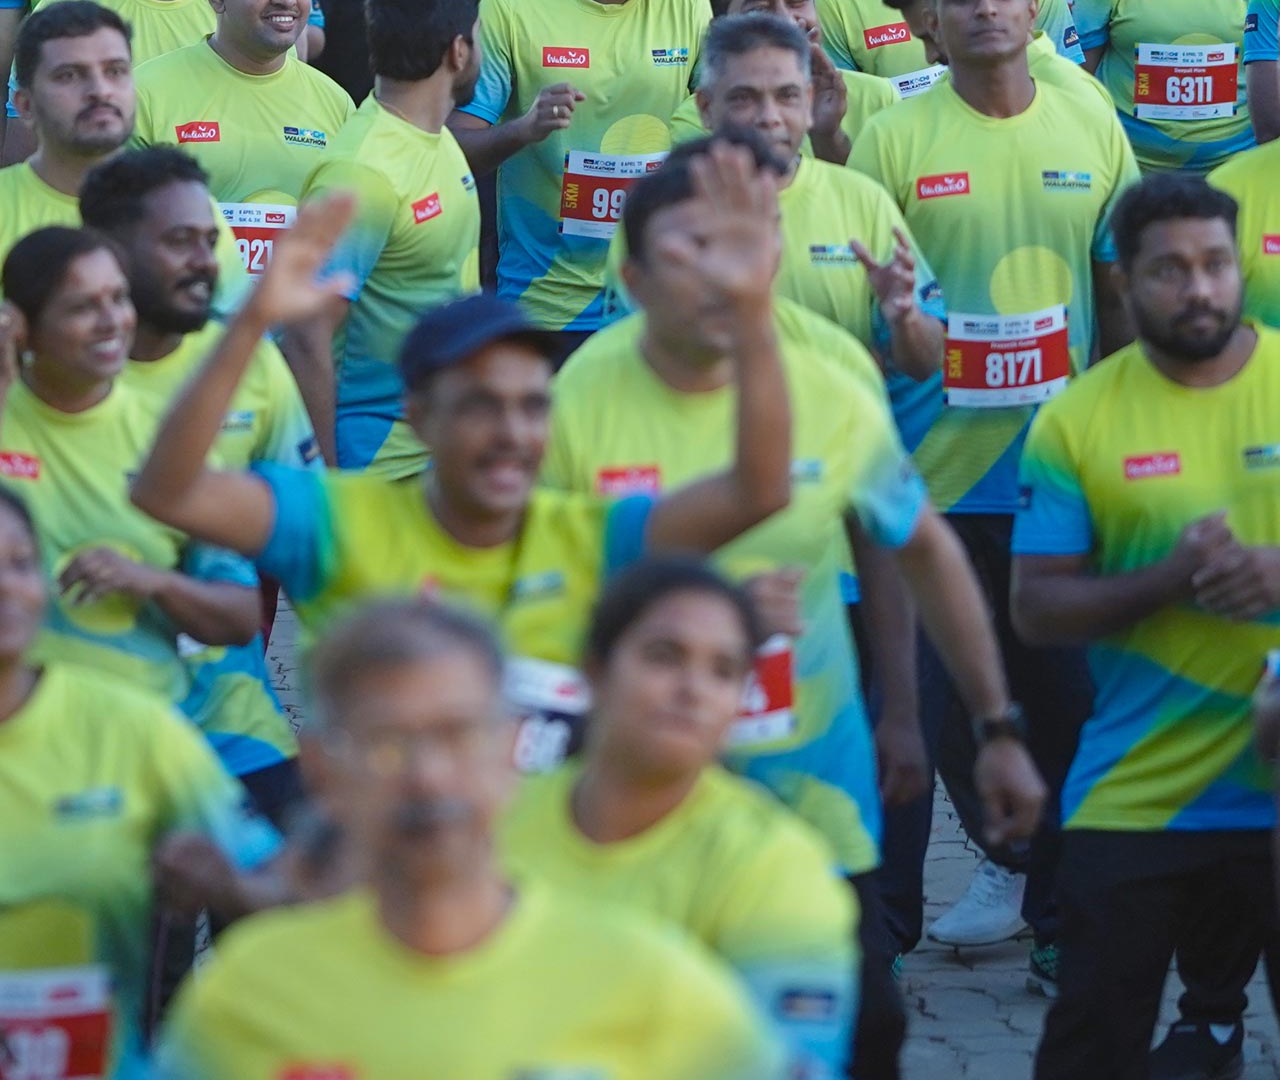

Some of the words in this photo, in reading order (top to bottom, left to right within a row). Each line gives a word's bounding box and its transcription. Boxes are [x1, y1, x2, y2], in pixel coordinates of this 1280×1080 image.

[1138, 73, 1150, 96] 5KM
[1166, 75, 1213, 104] 6311
[285, 135, 326, 147] WALKATHON
[565, 183, 580, 209] 5KM
[985, 348, 1042, 387] 8171
